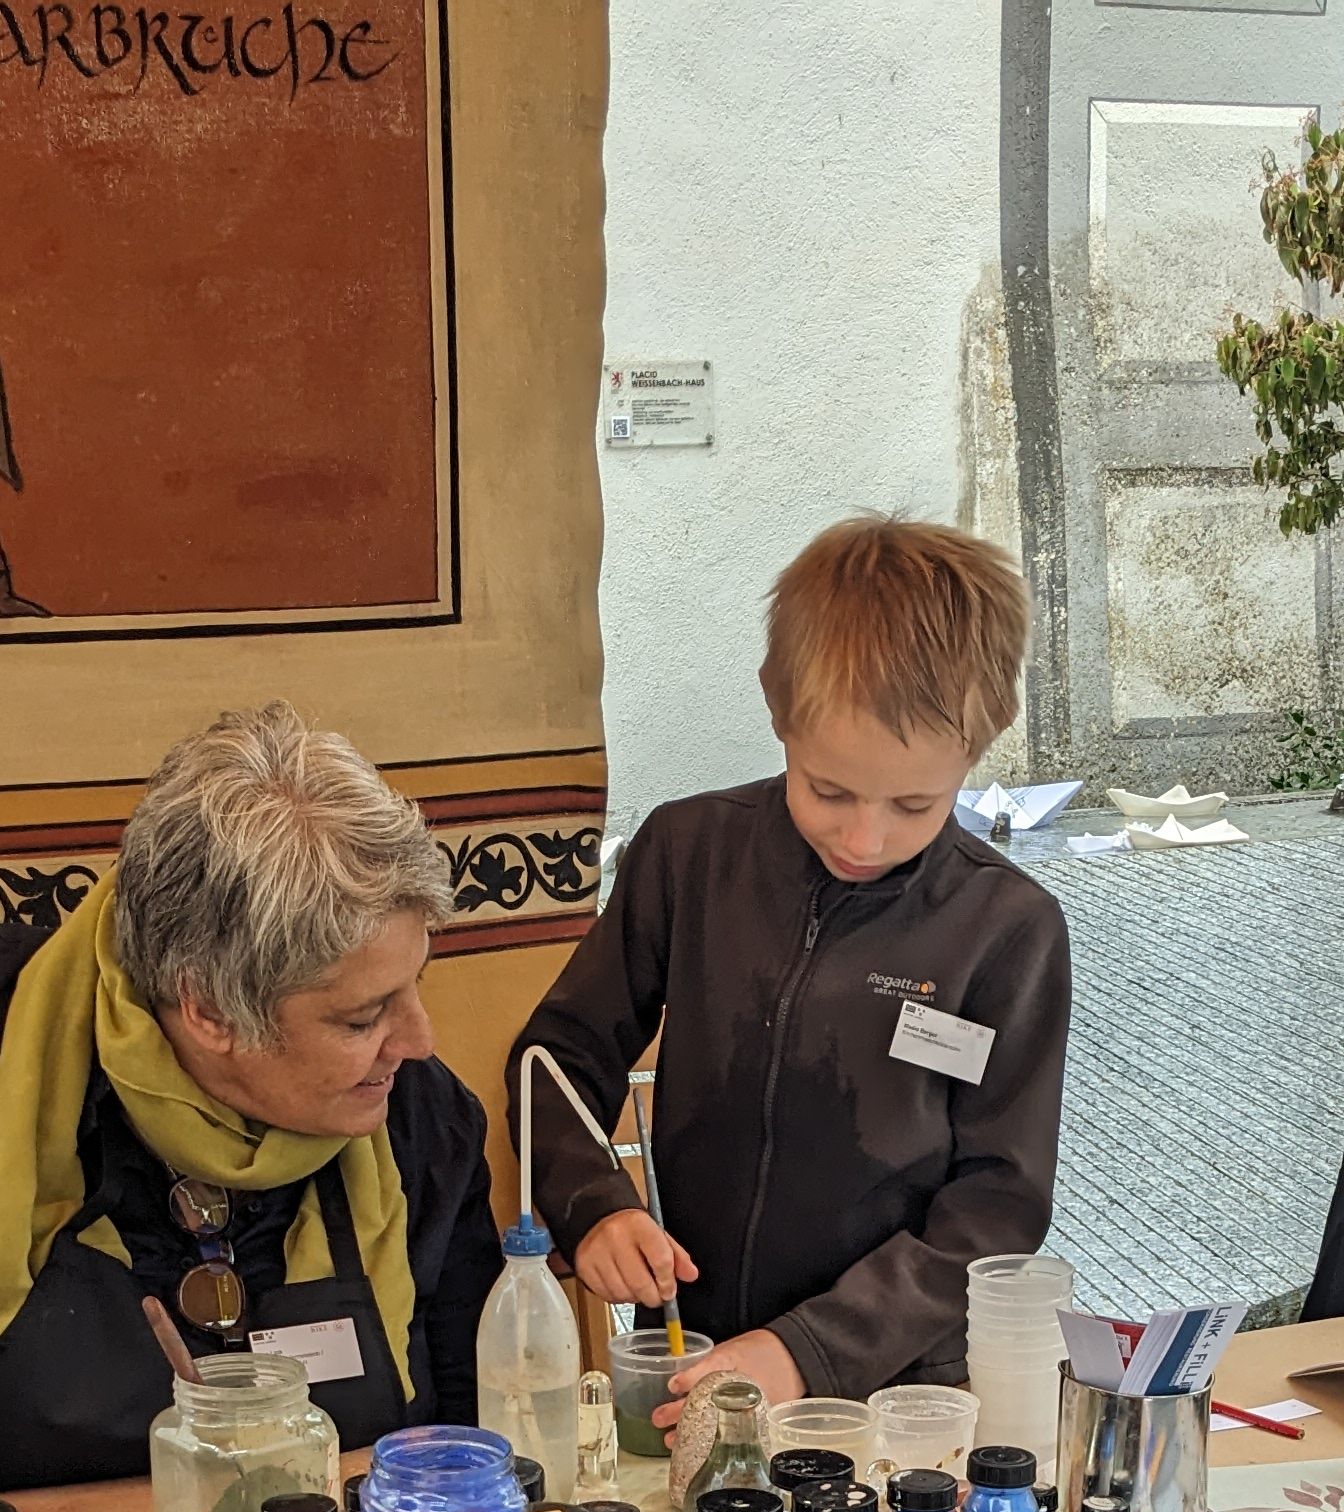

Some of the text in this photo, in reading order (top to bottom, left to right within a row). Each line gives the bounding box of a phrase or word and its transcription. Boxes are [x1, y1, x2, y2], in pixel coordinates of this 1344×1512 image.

[631, 371, 658, 379] PLACID
[631, 379, 706, 388] WEISSENBACH-HAUS
[867, 972, 921, 992] Regatta
[873, 986, 935, 1002] GREAT OUTDOORS
